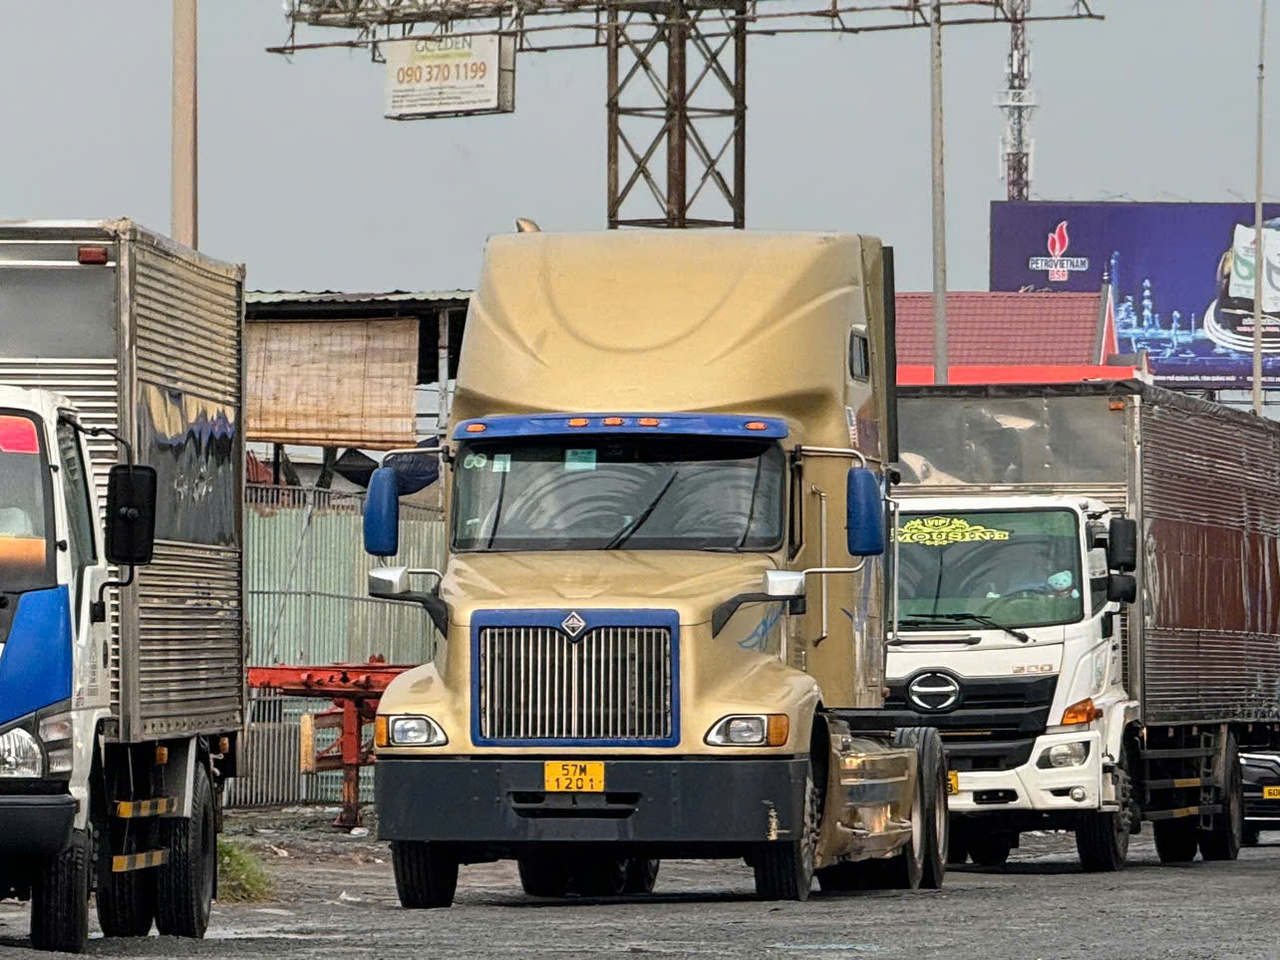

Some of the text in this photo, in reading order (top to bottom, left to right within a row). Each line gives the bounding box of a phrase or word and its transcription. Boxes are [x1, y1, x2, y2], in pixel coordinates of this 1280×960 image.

[397, 62, 487, 84] 090 370 1199
[1030, 258, 1087, 269] PETROVIETNAM
[1050, 270, 1067, 280] BSR
[890, 530, 1009, 542] MOUSINE
[562, 764, 587, 776] 57M
[555, 778, 594, 789] 1201
